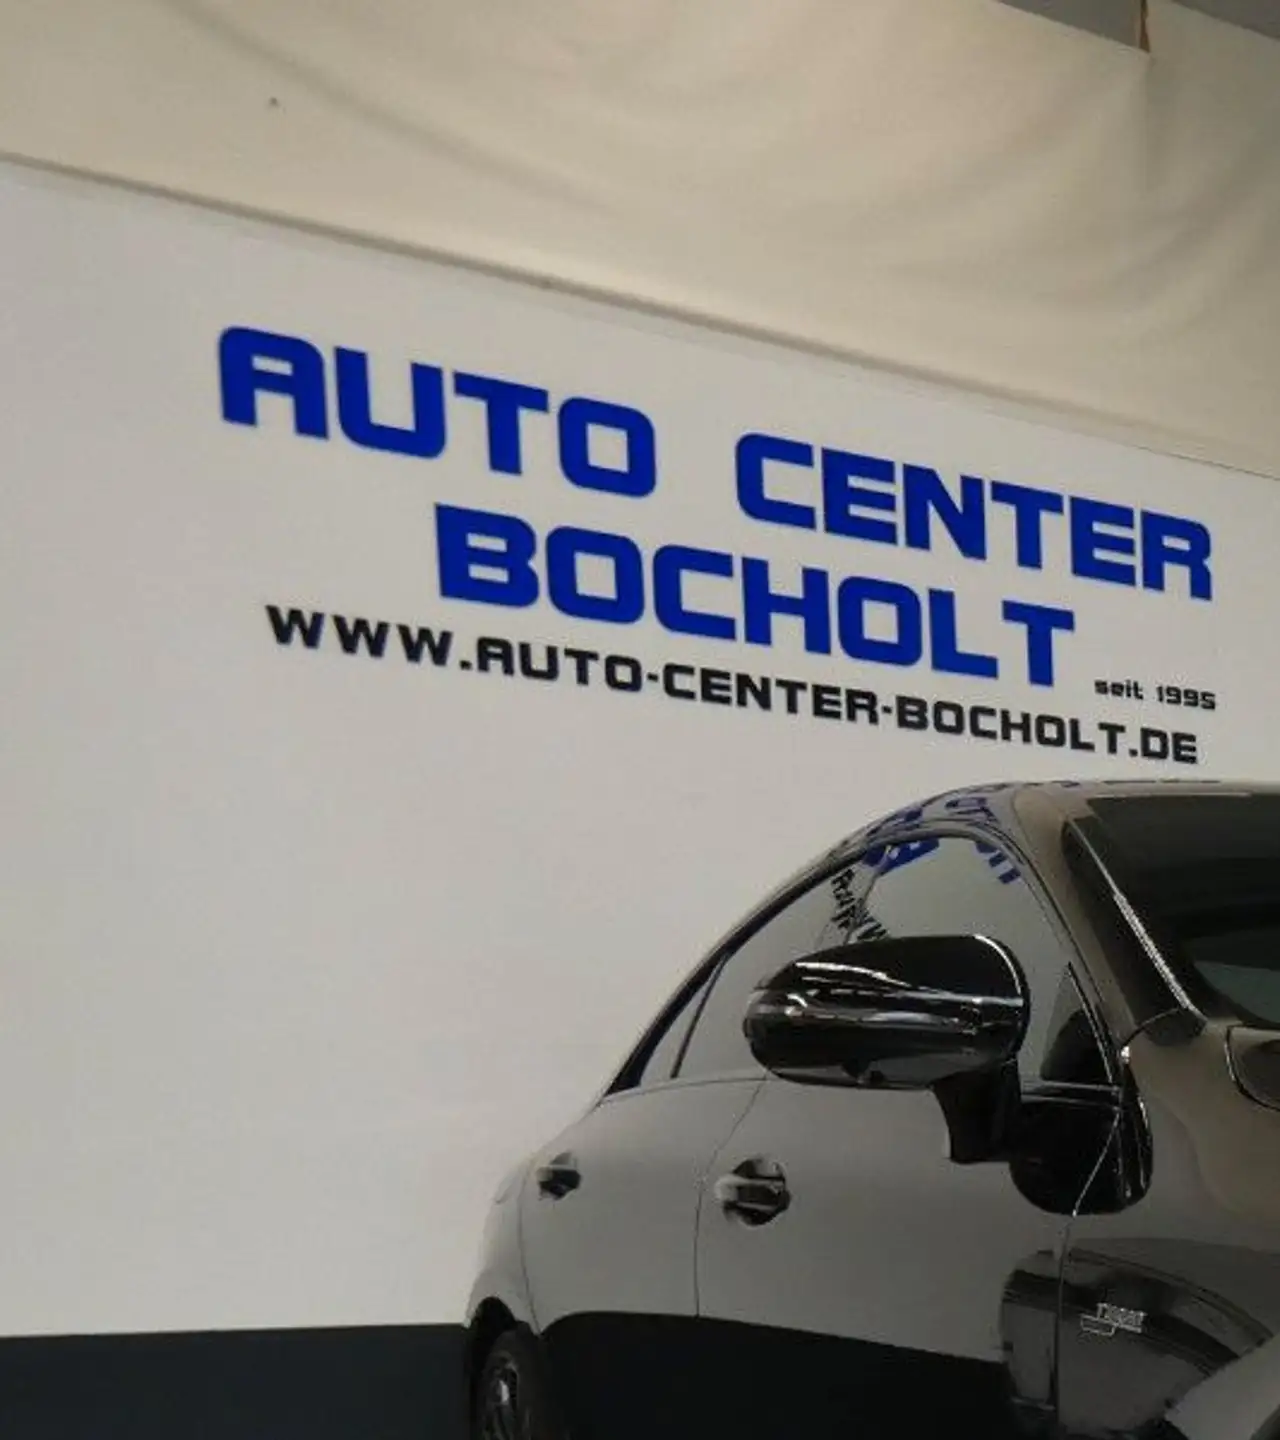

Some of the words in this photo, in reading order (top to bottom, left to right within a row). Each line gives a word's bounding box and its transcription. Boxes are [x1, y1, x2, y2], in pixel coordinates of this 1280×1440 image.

[219, 327, 656, 498] AUTO
[735, 433, 1212, 600] CENTER
[266, 606, 1200, 766] WWW.AUTO-CENTER-BOCHOLT.DE
[435, 503, 1075, 687] BOCHOLT
[1094, 679, 1144, 701] seit
[1156, 684, 1217, 711] 1995
